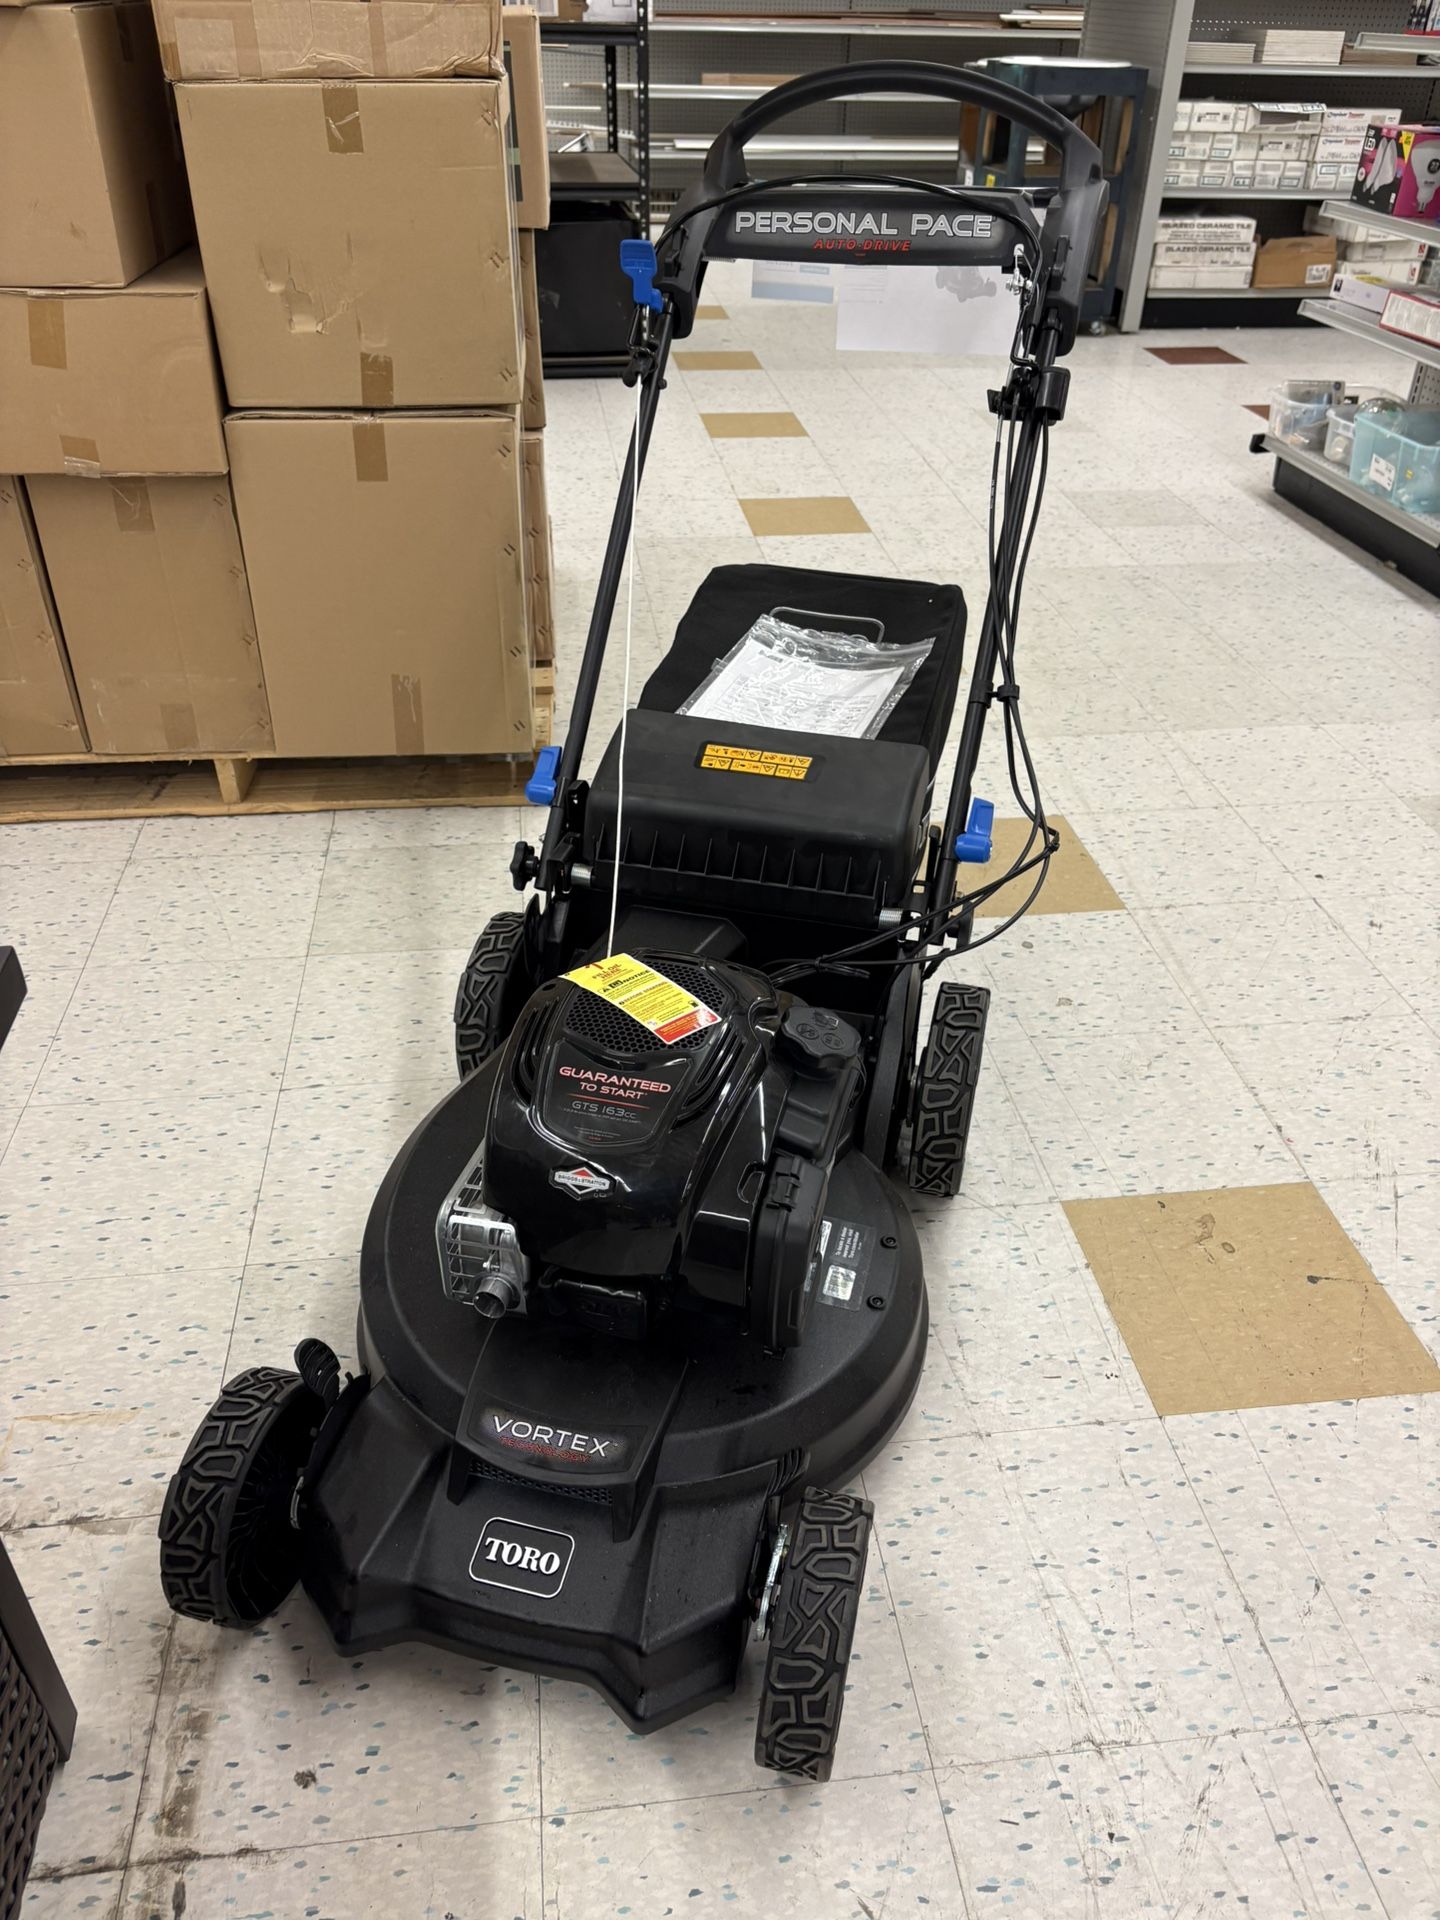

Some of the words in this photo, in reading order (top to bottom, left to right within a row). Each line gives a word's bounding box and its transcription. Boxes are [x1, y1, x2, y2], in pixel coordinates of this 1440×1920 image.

[735, 211, 898, 235] PERSONAL
[911, 213, 994, 238] PACE
[559, 1066, 672, 1093] GUARANTEED
[580, 1081, 597, 1092] TO
[600, 1085, 645, 1100] START
[571, 1100, 599, 1113] GTS
[493, 1415, 611, 1457] VORTEX
[484, 1537, 561, 1575] TORO
